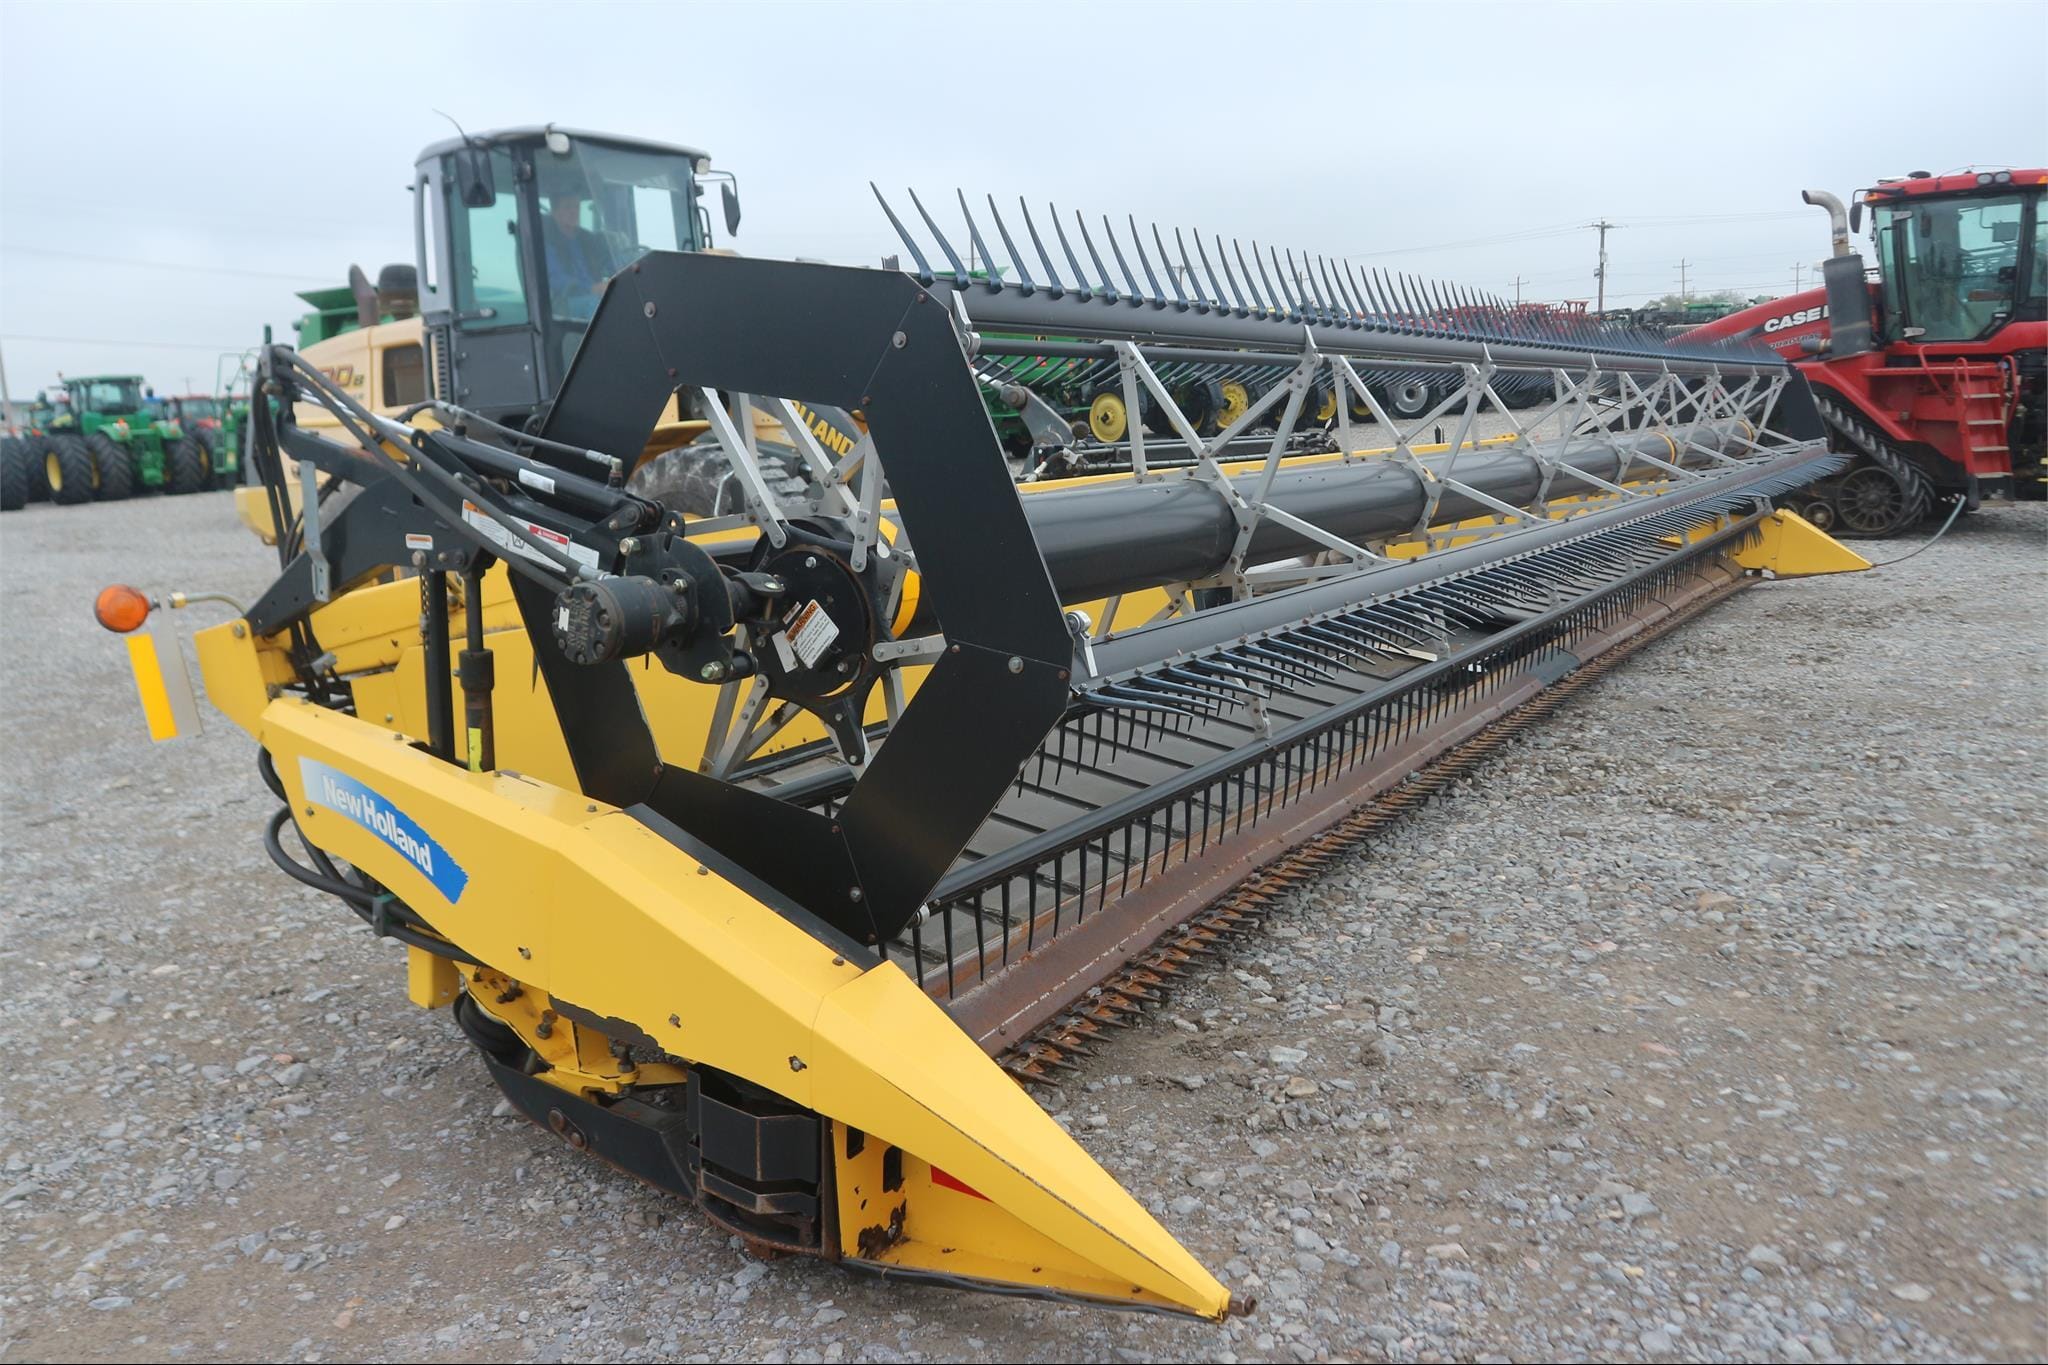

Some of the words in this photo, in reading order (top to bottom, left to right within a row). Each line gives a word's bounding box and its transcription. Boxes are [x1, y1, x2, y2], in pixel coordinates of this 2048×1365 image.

[1764, 307, 1821, 332] CASE
[791, 400, 855, 457] LLAND
[322, 775, 361, 818] New
[361, 794, 434, 876] Holland
